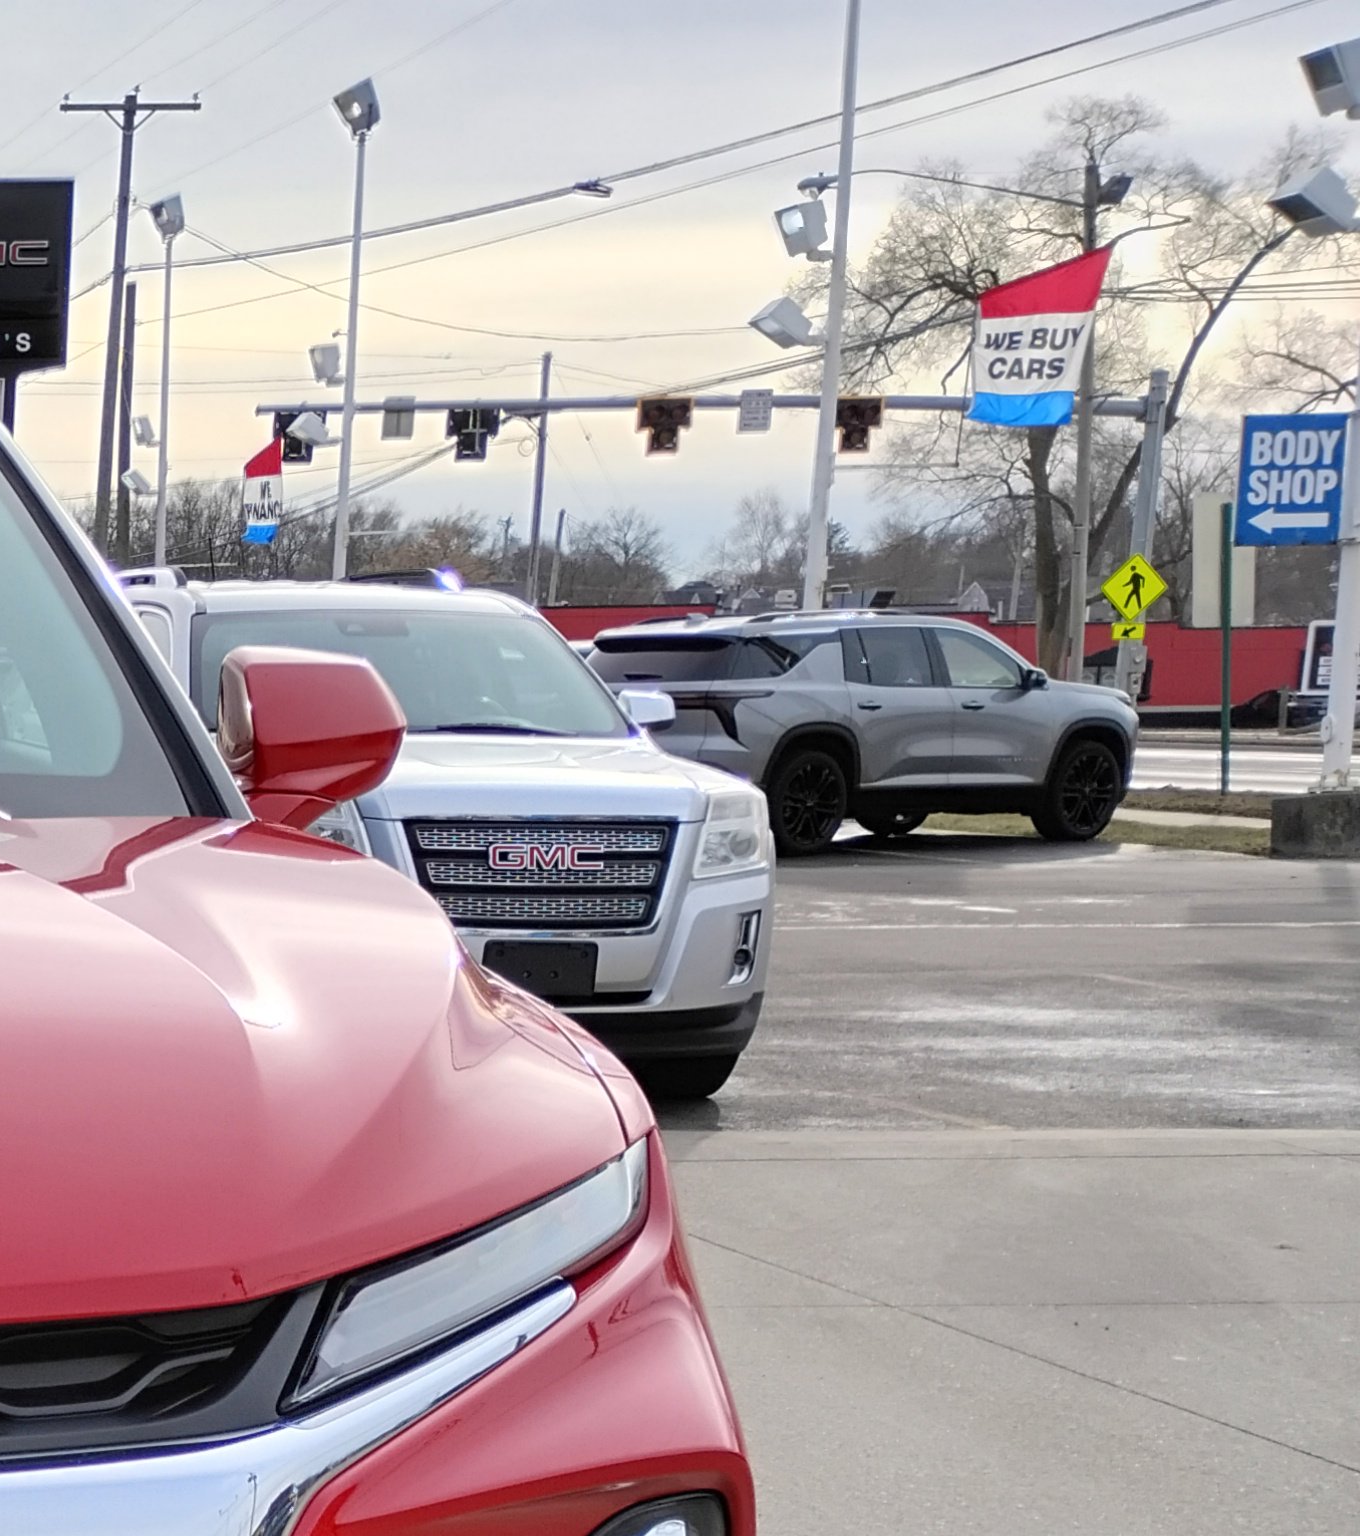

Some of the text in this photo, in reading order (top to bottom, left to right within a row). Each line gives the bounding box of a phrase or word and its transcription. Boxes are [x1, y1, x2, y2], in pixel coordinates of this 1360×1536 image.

[984, 325, 1085, 350] WE BUY
[987, 357, 1065, 380] CARS
[1250, 430, 1342, 466] BODY
[1247, 469, 1338, 505] SHOP
[488, 844, 605, 870] GMC
